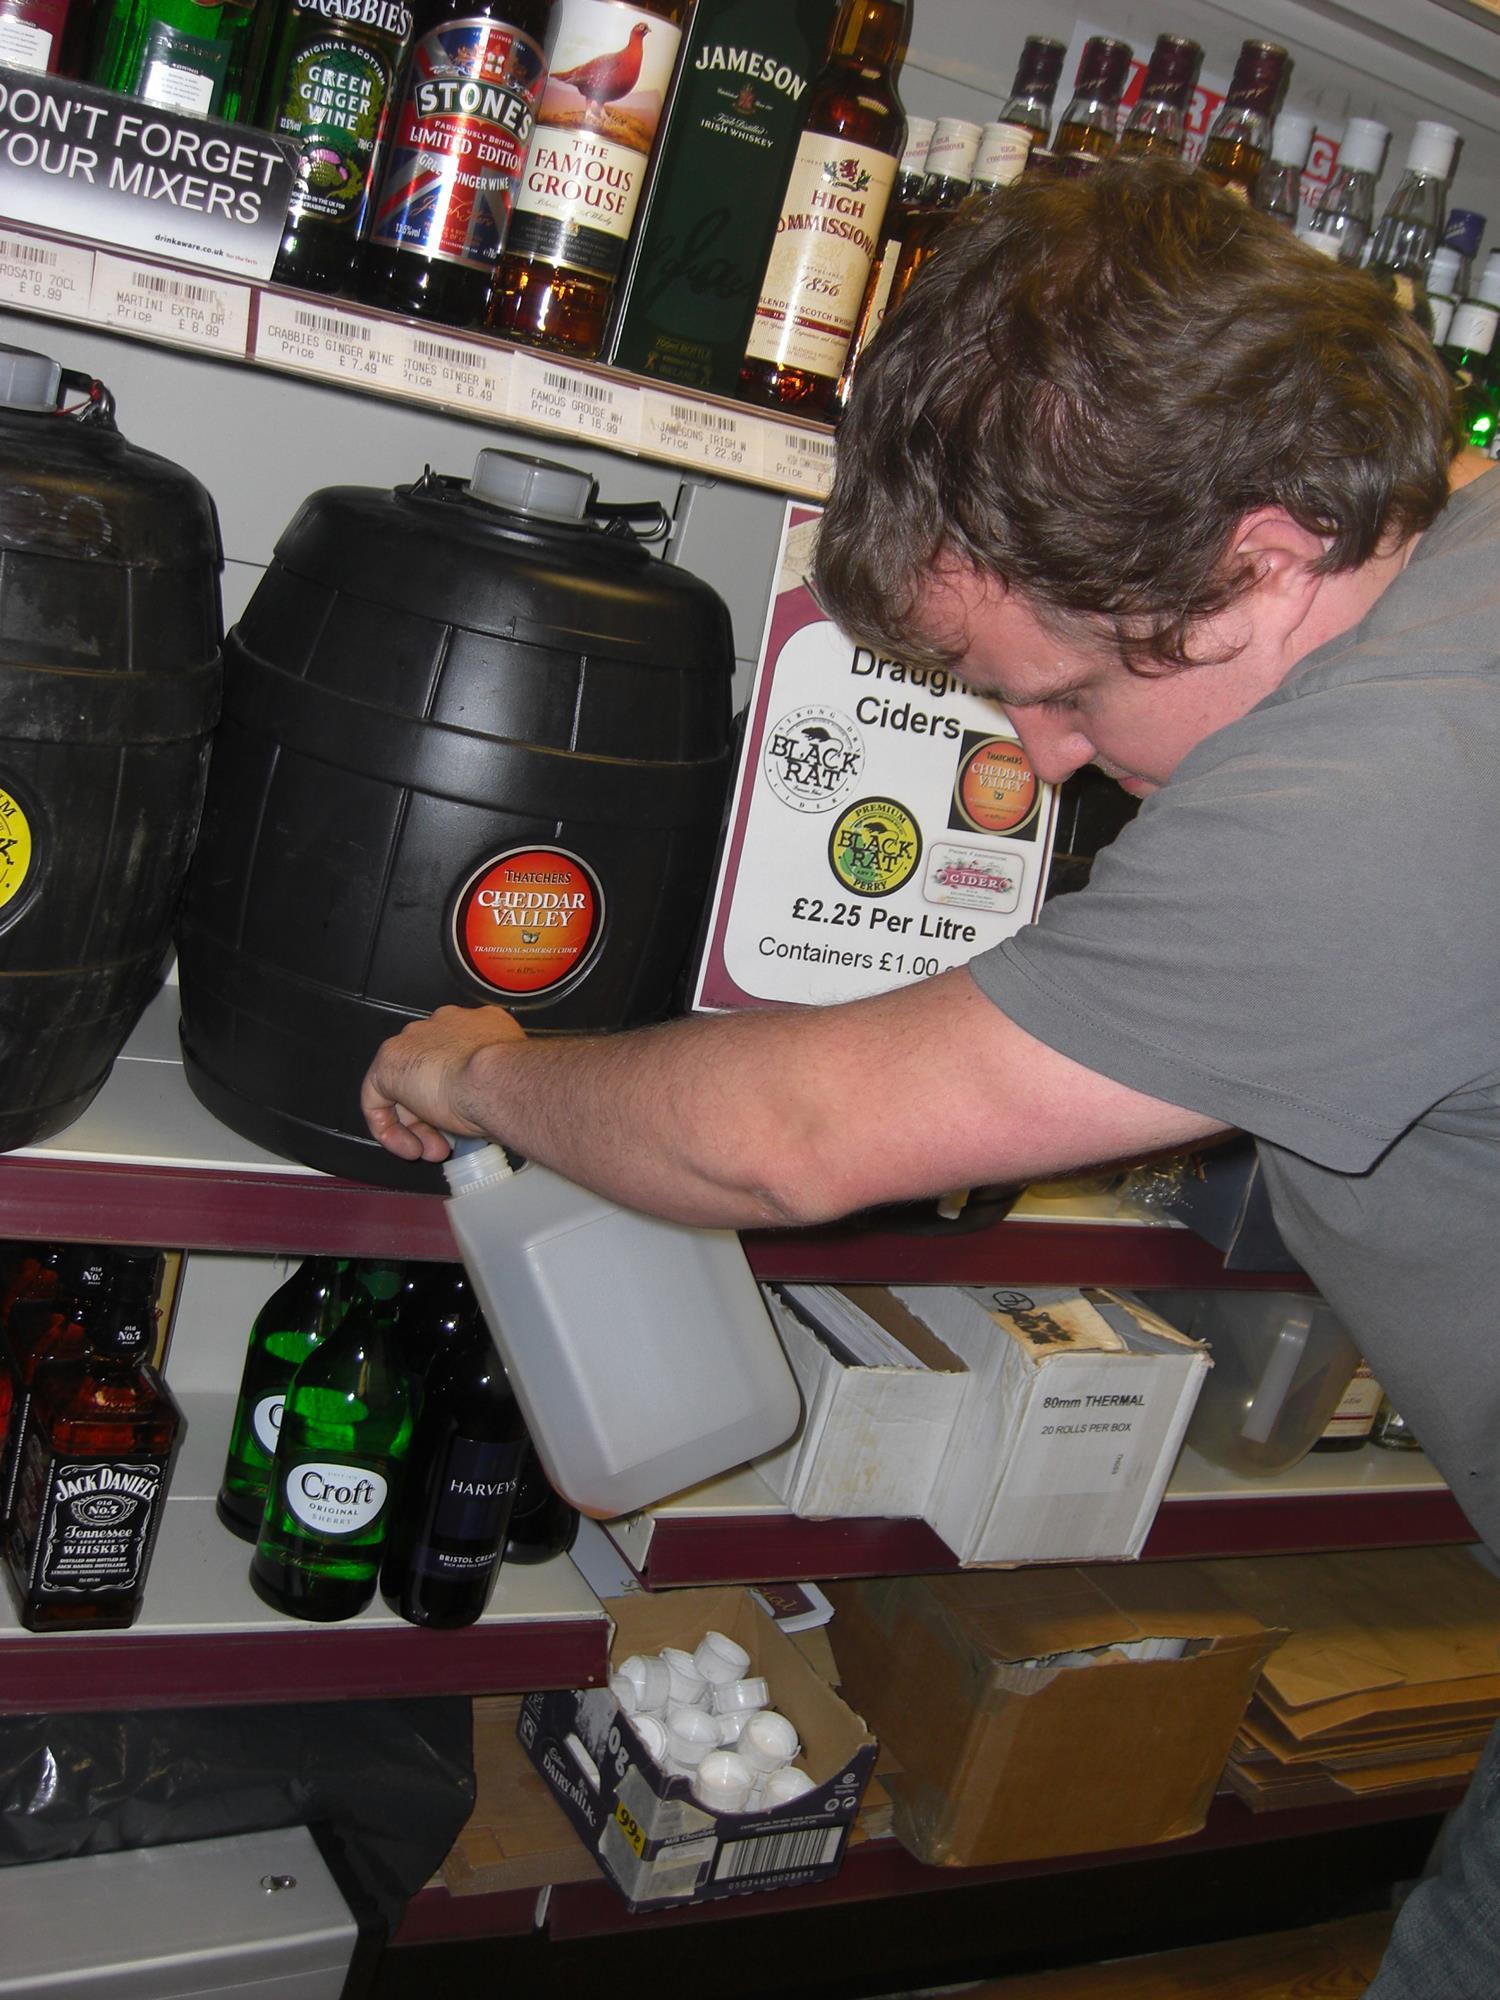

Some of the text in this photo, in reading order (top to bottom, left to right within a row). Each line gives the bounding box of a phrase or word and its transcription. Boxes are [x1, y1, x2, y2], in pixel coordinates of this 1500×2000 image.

[297, 41, 347, 64] ORIGINAL
[308, 66, 373, 97] GREEN
[695, 45, 808, 102] JAMESON
[300, 84, 371, 116] GINGER
[420, 82, 533, 141] STONE'S
[308, 103, 359, 131] WINE
[409, 126, 472, 155] LIMITED
[489, 135, 515, 149] BRITISH
[701, 119, 774, 148] IRISH WHISKEY
[113, 114, 285, 187] FORGET
[572, 139, 609, 160] THE
[534, 147, 634, 193] FAMOUS
[108, 156, 263, 225] MIXERS
[488, 176, 509, 191] WINE
[528, 171, 628, 216] GROUSE
[811, 189, 866, 219] HIGH
[154, 233, 224, 257] drinkaware.co.uk
[19, 281, 63, 301] £ 8.99
[49, 275, 77, 291] 70CL
[117, 291, 225, 326] MARTINI EXTRA DR
[799, 305, 833, 321] SCOTCH
[117, 304, 220, 338] Price £ 8.99
[268, 324, 395, 367] CRABBIES GINGER WINE
[281, 342, 378, 375] Price £ 7.49
[442, 367, 480, 386] GINGER
[484, 378, 497, 391] WI
[455, 382, 463, 395] £
[530, 387, 623, 425] FAMOUS GROUSE WH
[530, 401, 562, 419] Price
[577, 412, 585, 425] £
[660, 433, 689, 450] Price
[714, 447, 744, 464] 22.99
[709, 432, 740, 450] IRISH
[856, 696, 961, 739] Ciders
[768, 733, 861, 776] BLACK
[986, 751, 1024, 765] THATCHERS
[783, 759, 841, 791] RAT
[970, 762, 1032, 783] CHEDDAR
[978, 774, 1025, 793] VALLEY
[855, 803, 907, 824] PREMIUM
[837, 829, 914, 860] BLACK
[850, 849, 898, 873] RAT
[504, 869, 572, 885] THATCHERS
[852, 878, 888, 891] PERRY
[949, 873, 999, 889] CIDER
[477, 888, 587, 911] CHEDDAR
[491, 908, 575, 928] VALLEY
[791, 896, 977, 942] £2.25 Per Litre
[474, 945, 578, 954] TRADITIONAL SOMERSET CIDER
[758, 936, 939, 977] Containers £1.00
[117, 1330, 142, 1341] No.7
[1042, 1394, 1145, 1409] 80mm THERMAL
[1040, 1422, 1132, 1435] 20 ROLLS PER BOX
[55, 1467, 160, 1502] JACK DANIEL'S
[301, 1471, 376, 1504] Croft
[450, 1477, 518, 1497] HARVEYS
[87, 1505, 119, 1515] No.7
[308, 1502, 360, 1516] ORIGINAL
[312, 1513, 353, 1525] SHERRY
[64, 1525, 133, 1539] Tennessee
[63, 1543, 129, 1555] WHISKEY
[438, 1553, 473, 1564] BRISTOL
[543, 1753, 573, 1794] DAIRY
[569, 1787, 597, 1828] MILK
[620, 1808, 642, 1844] 99p
